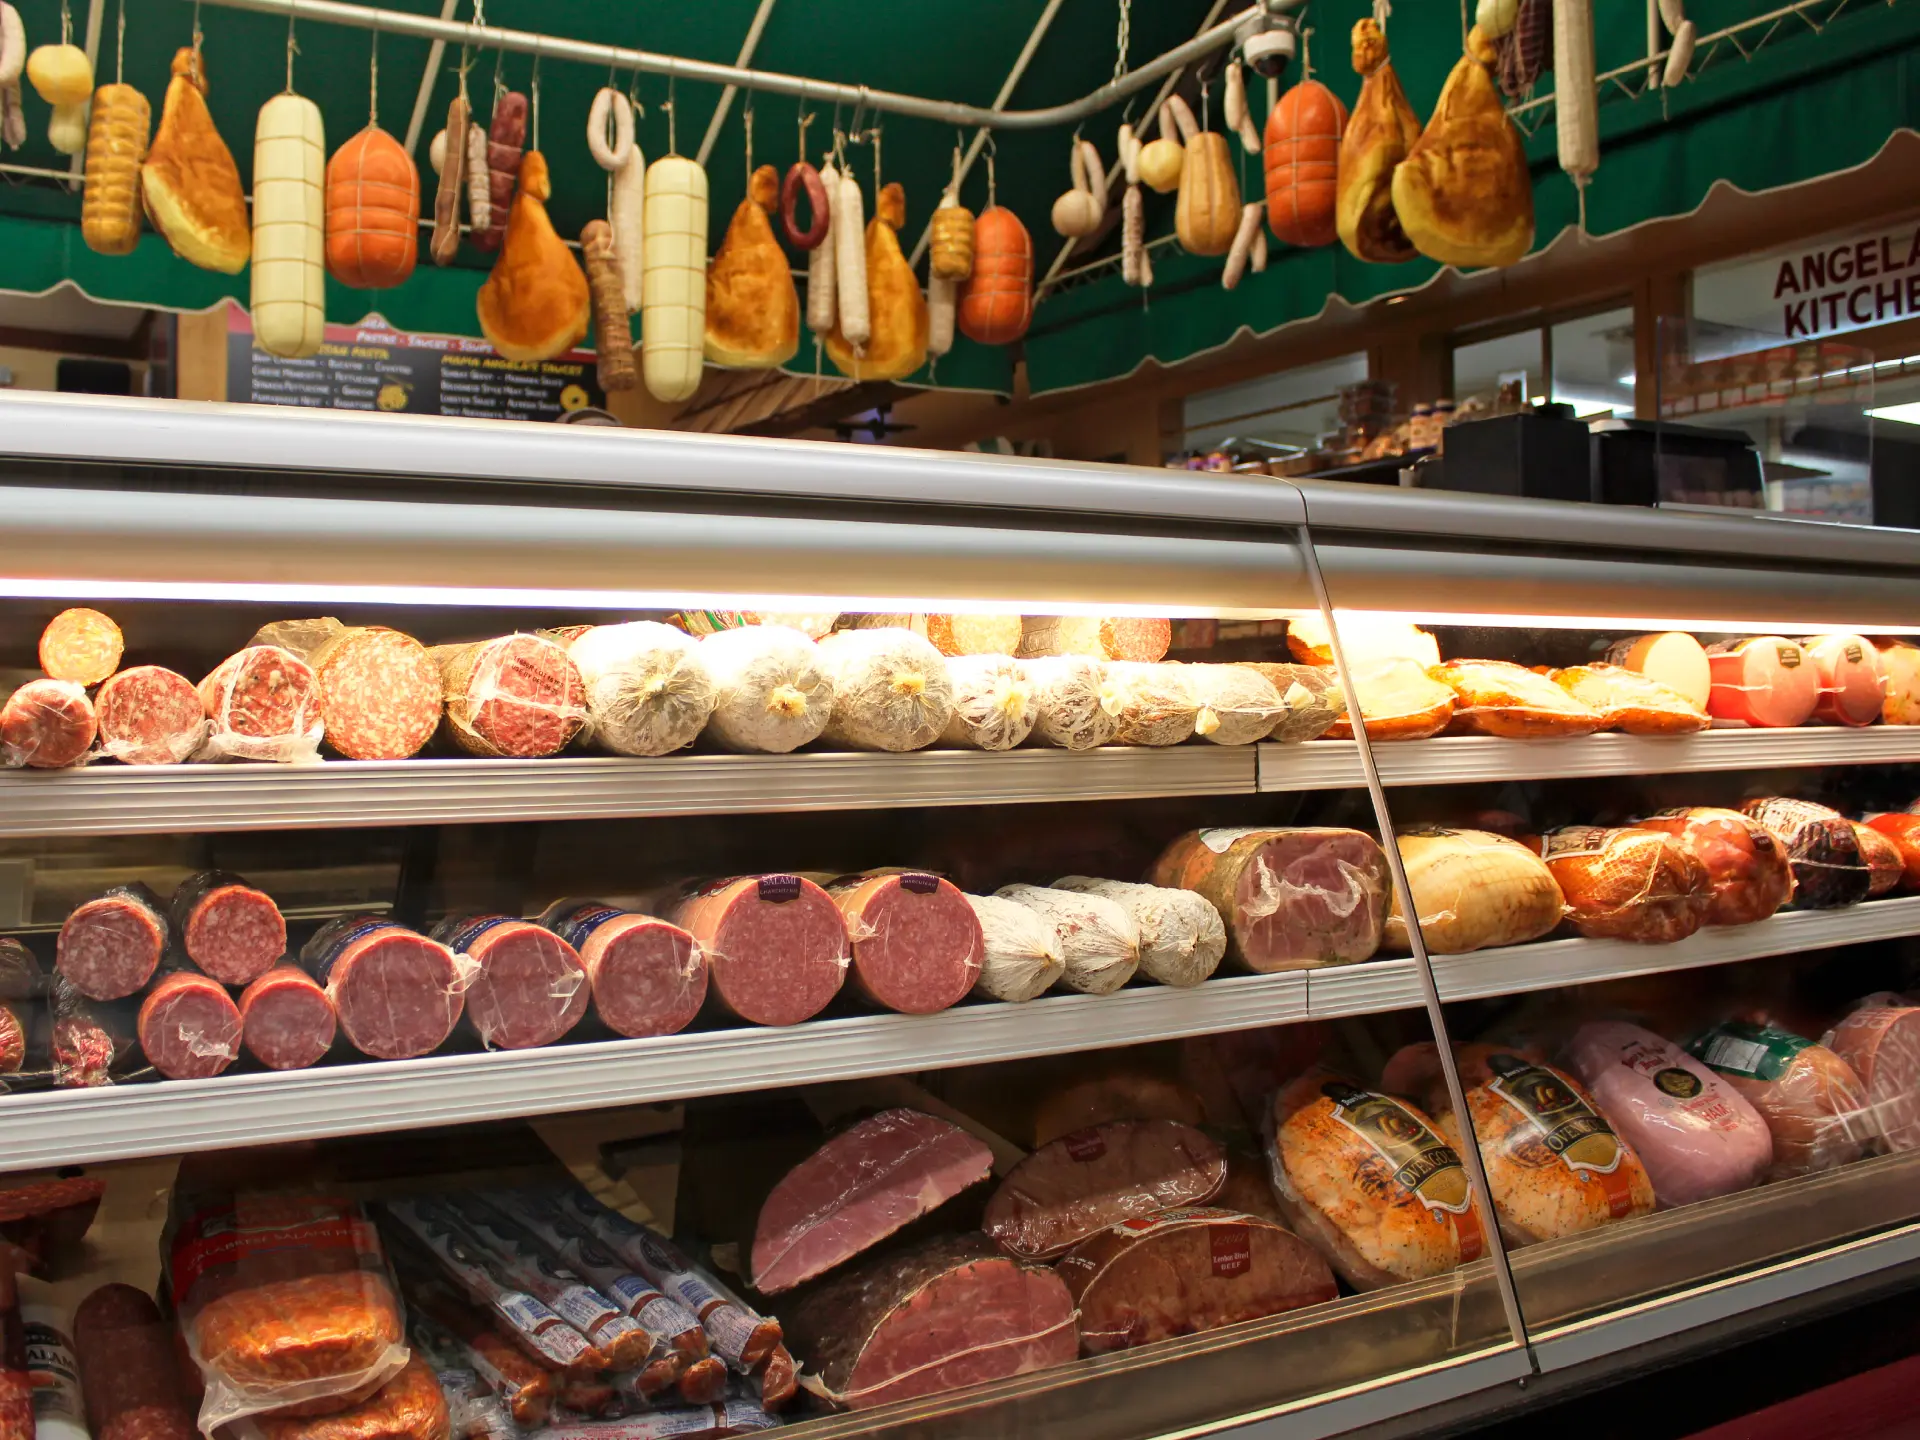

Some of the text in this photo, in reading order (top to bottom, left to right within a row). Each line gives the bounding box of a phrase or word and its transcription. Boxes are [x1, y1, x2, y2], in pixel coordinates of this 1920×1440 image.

[762, 876, 796, 886] SALAMI
[1702, 1104, 1730, 1122] HAM
[1547, 1118, 1605, 1151] OVENGO
[1220, 1261, 1241, 1271] BEEF
